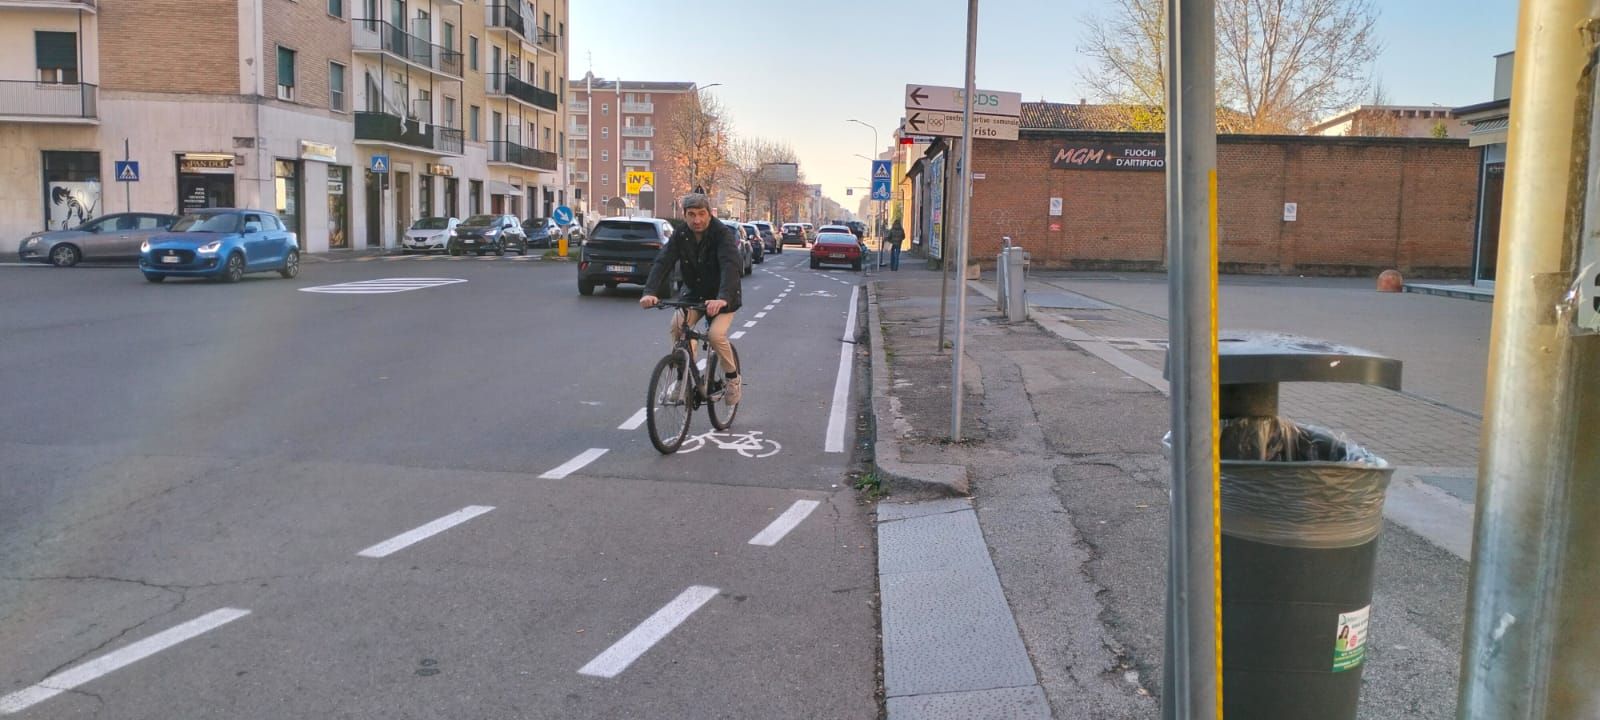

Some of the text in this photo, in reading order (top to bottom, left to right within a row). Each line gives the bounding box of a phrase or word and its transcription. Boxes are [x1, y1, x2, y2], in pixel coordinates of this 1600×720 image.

[974, 127, 997, 137] risto
[1053, 148, 1105, 165] MGM
[1124, 148, 1157, 157] FUOCHI
[1116, 158, 1165, 168] D'ARTIFICIO
